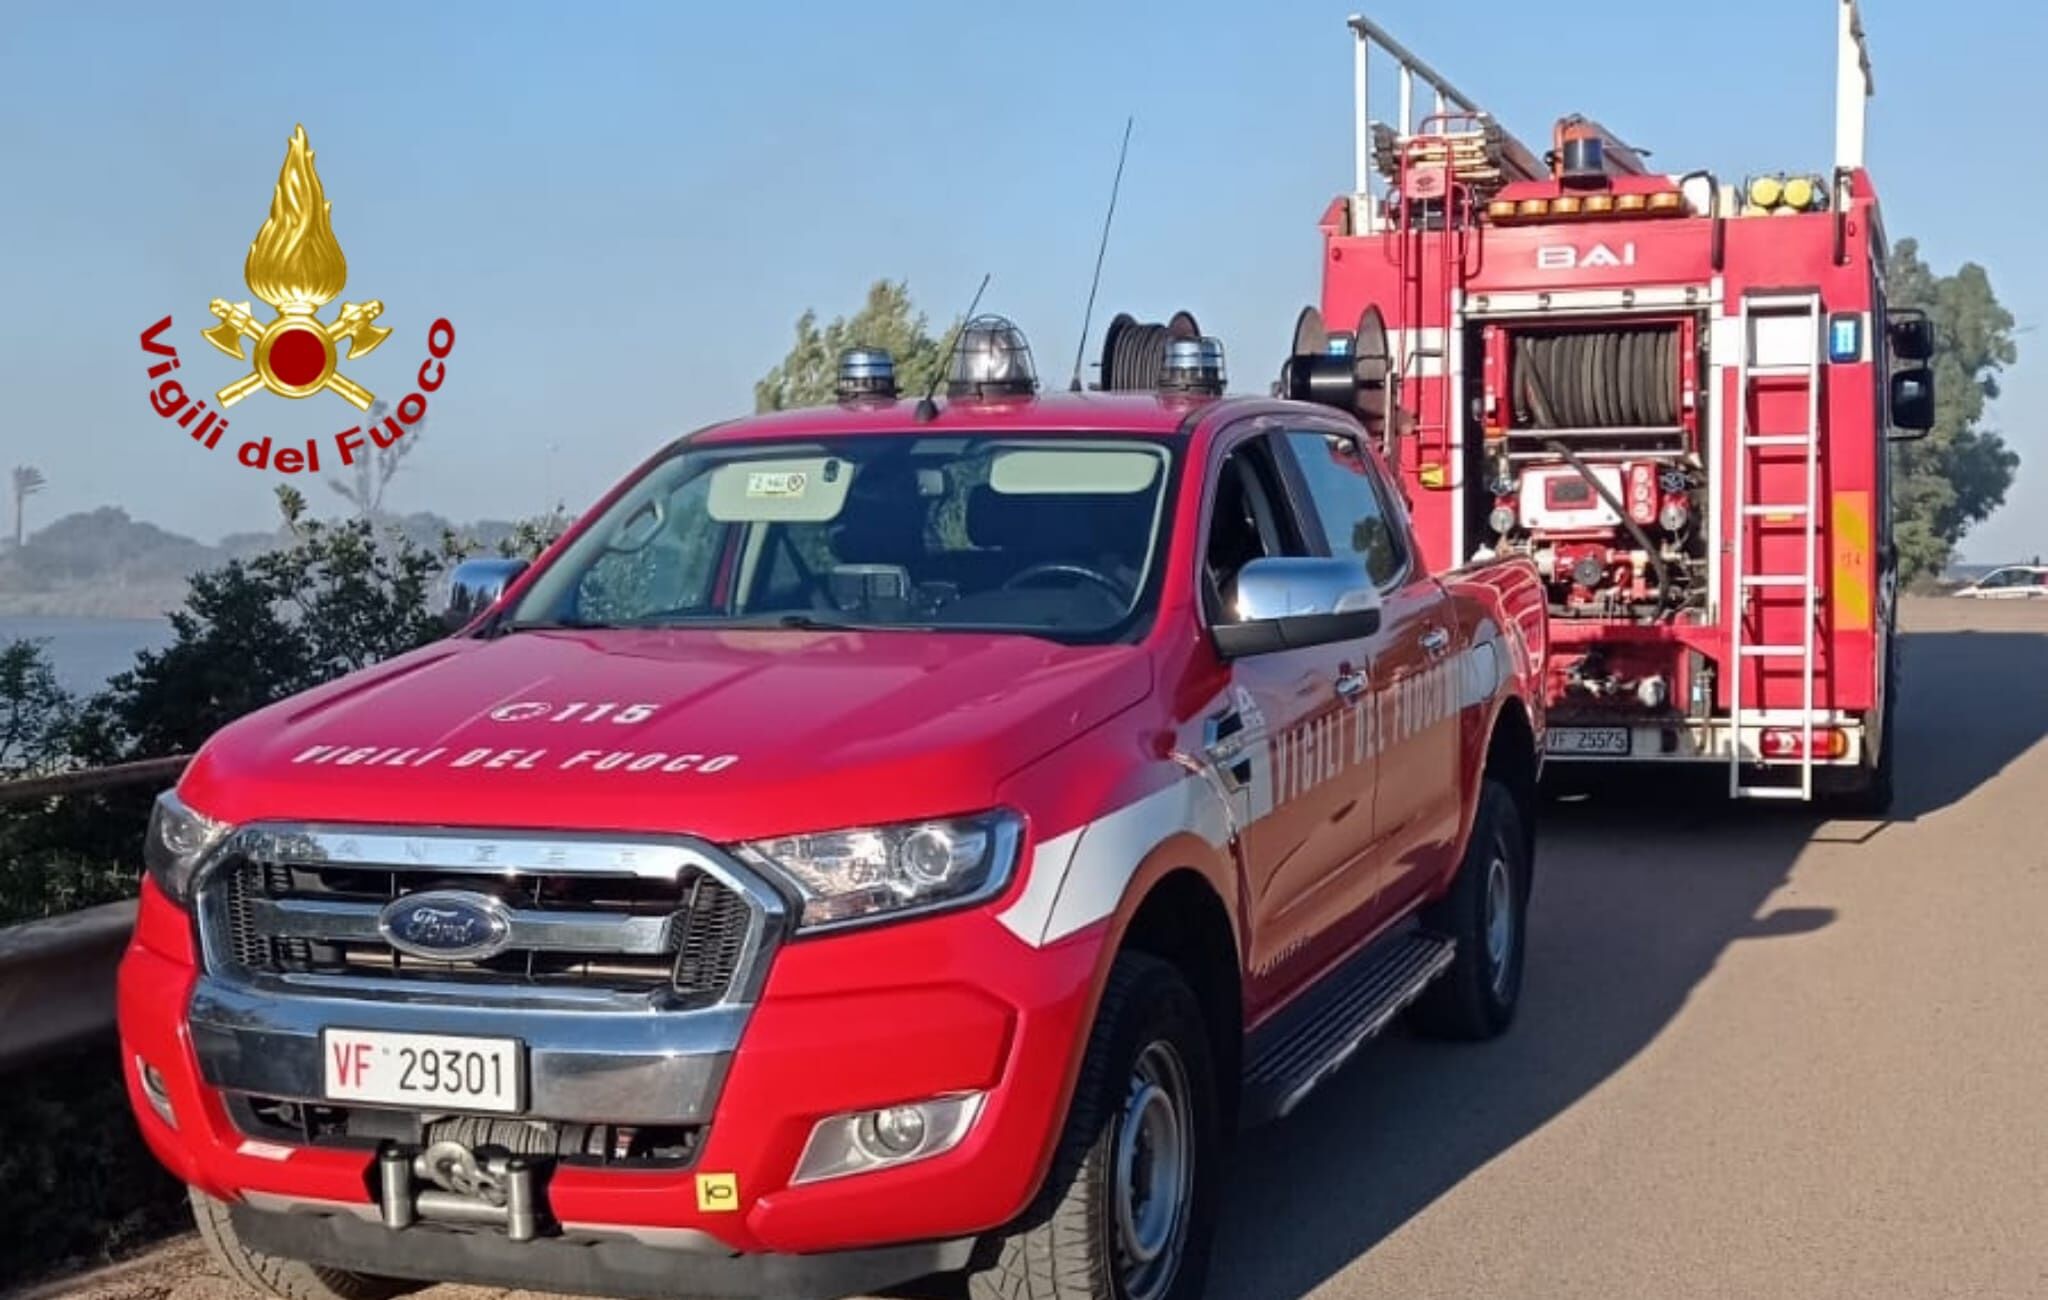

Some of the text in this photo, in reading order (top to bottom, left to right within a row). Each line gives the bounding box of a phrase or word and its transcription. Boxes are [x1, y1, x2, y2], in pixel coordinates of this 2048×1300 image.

[1536, 241, 1635, 269] BAI
[550, 702, 662, 724] 115
[1275, 708, 1344, 806] VIGILI
[1353, 690, 1385, 766] DEL
[1549, 730, 1568, 747] VF
[291, 745, 739, 773] VIGILI DEL FUOCO
[404, 907, 476, 943] Ford
[333, 1041, 501, 1097] VF 29301
